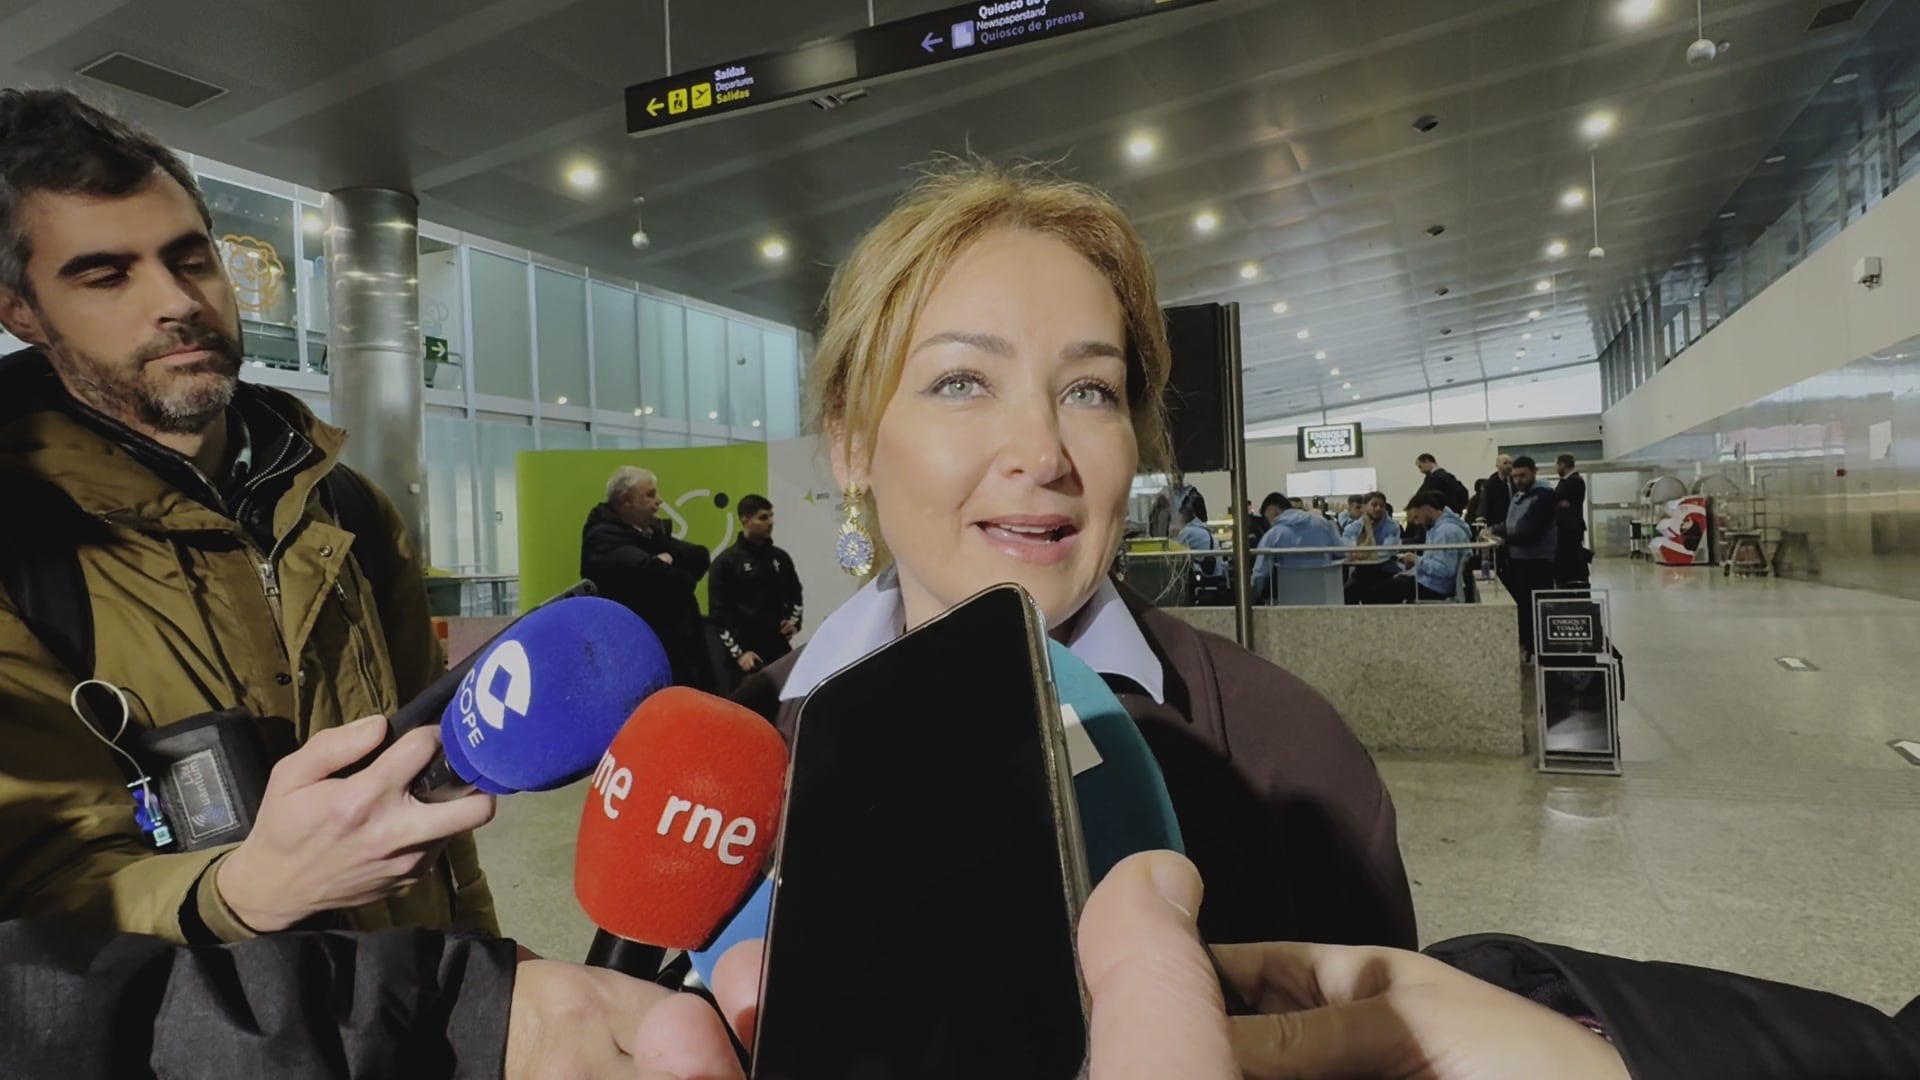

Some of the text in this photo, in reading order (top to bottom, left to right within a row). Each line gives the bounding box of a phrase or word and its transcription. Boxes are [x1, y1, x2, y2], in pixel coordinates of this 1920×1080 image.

[976, 5, 1046, 30] Newspaperstand
[978, 0, 1024, 19] Quiosco
[980, 11, 1085, 45] Quiosco de prensa
[715, 77, 754, 92] Departures
[716, 89, 750, 104] Salidas
[459, 667, 485, 748] COPE
[656, 795, 757, 865] rne
